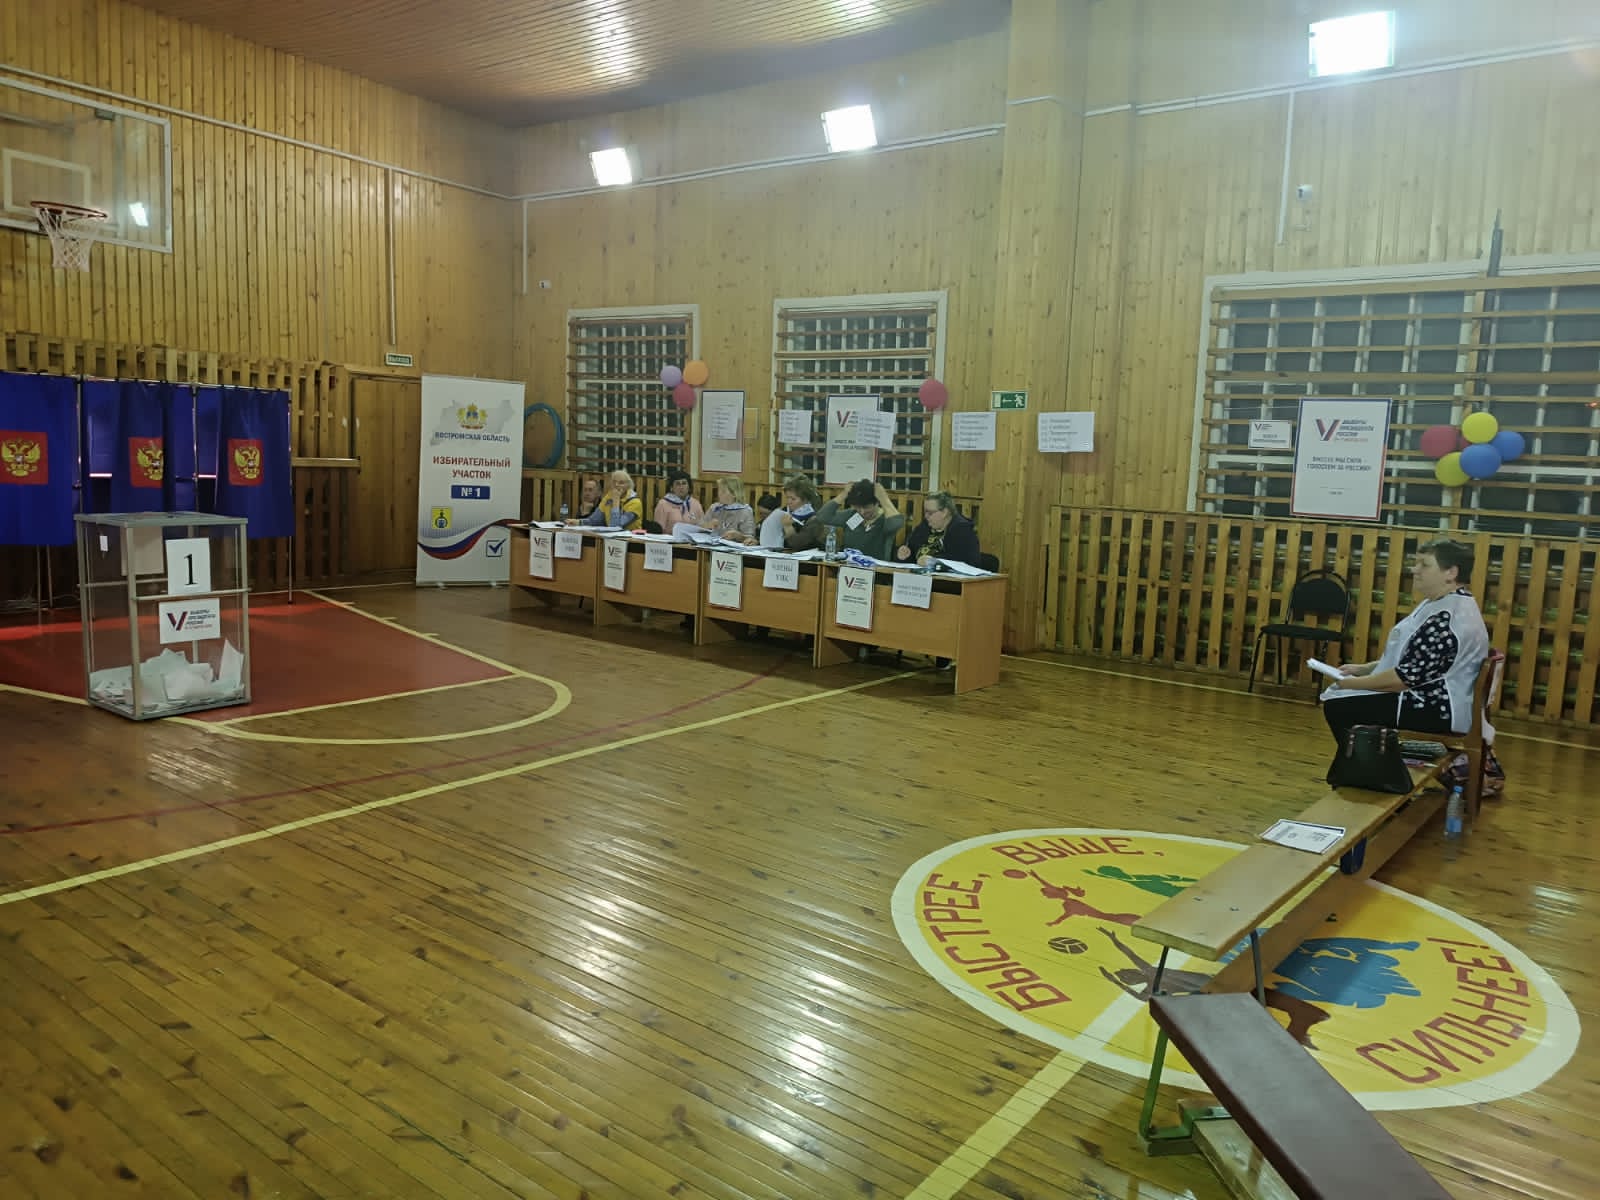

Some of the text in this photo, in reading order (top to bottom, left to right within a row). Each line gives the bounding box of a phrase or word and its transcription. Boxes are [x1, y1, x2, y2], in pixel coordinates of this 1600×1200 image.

[482, 434, 511, 442] ОБЛАСТЬ
[433, 456, 511, 468] ИЗБИРАТЕЛЬНЫЙ
[452, 469, 491, 479] УЧАСТОК
[461, 487, 481, 497] № 1
[184, 553, 198, 585] 1
[923, 873, 1072, 1012] БЫСТРЕЕ,
[1355, 937, 1531, 1084] СИЛЬНЕЕ!
